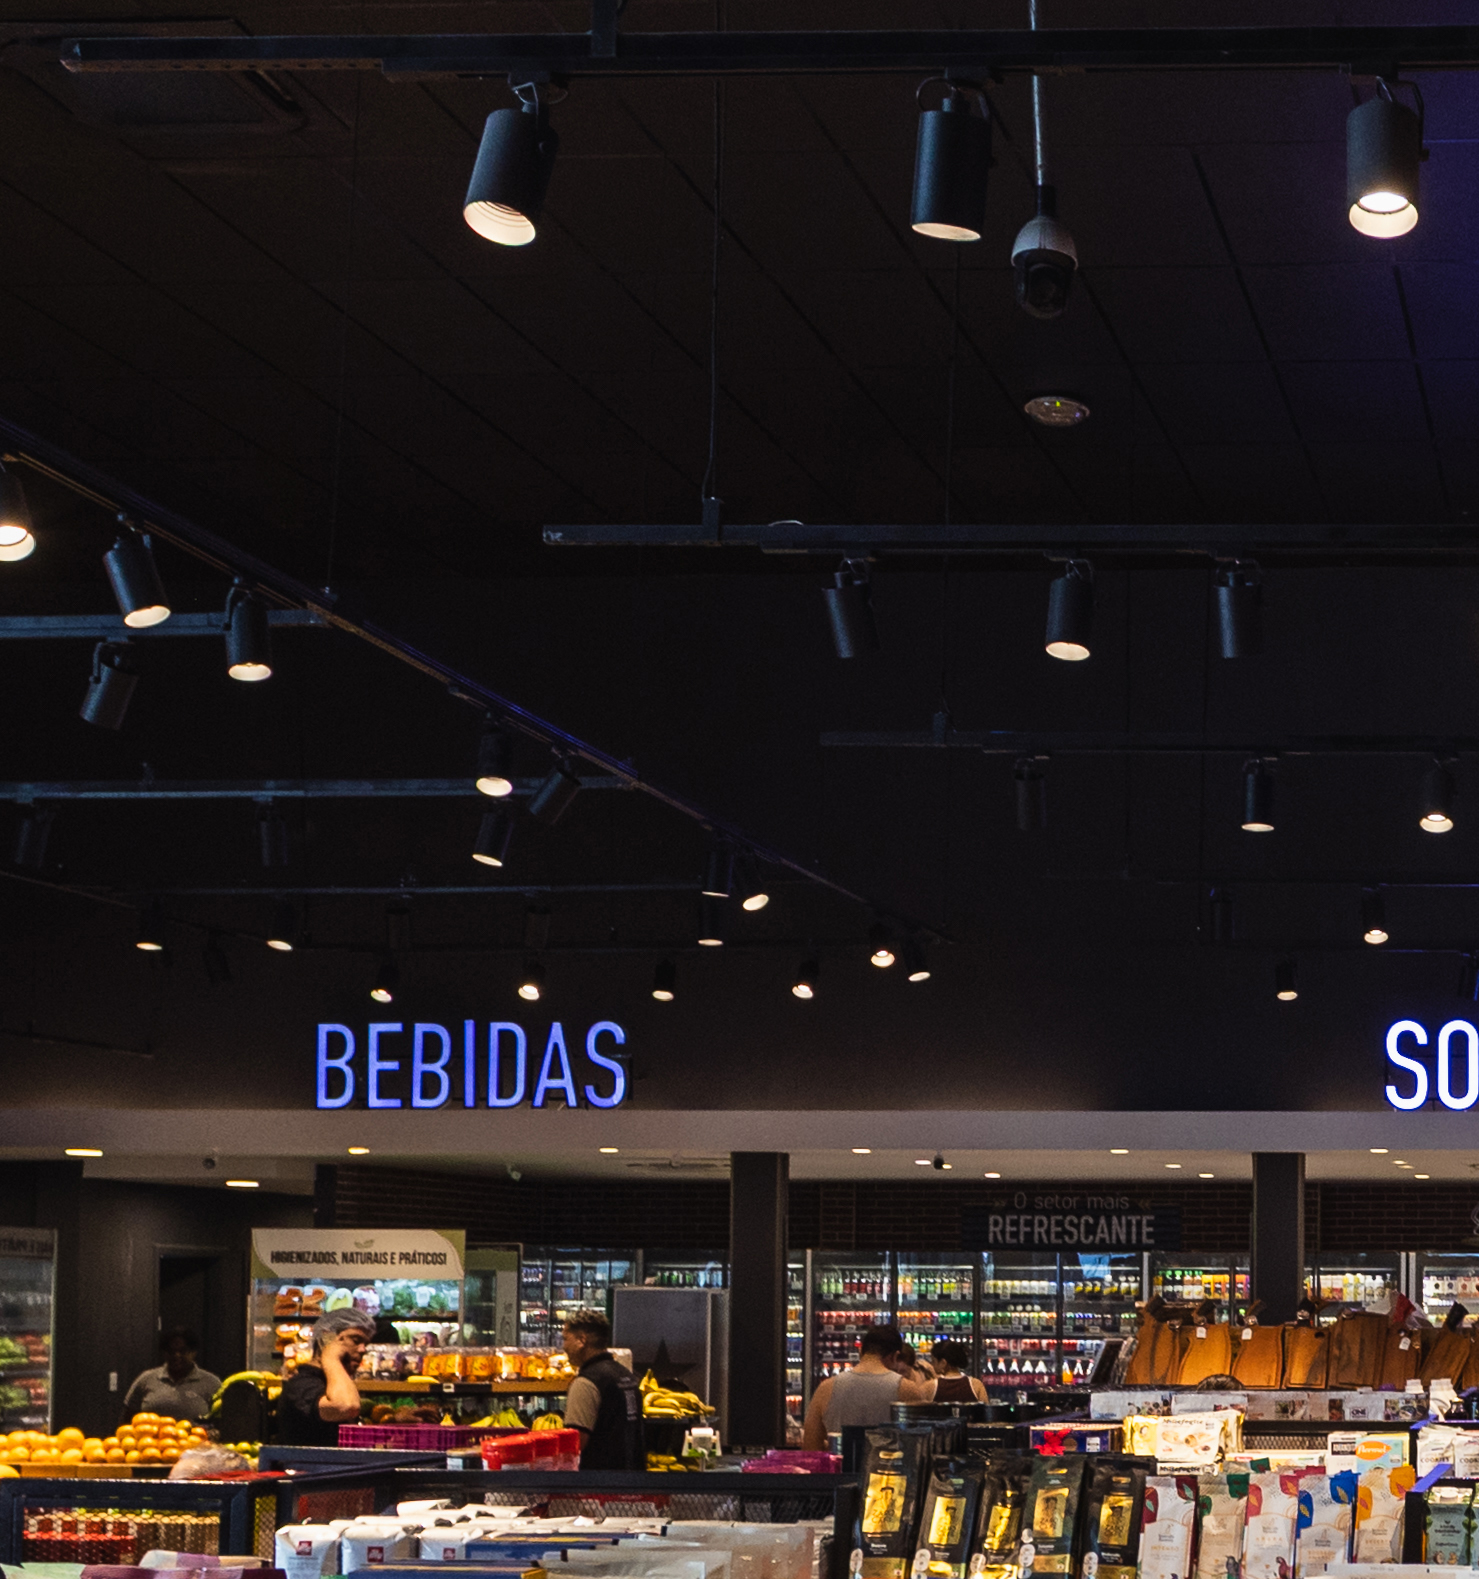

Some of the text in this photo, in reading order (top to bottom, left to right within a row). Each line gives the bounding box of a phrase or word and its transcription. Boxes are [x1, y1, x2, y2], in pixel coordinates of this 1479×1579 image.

[317, 1019, 628, 1109] BEBIDAS
[1014, 1192, 1129, 1209] O setor mais
[988, 1215, 1155, 1244] REFRESCANTE
[342, 1252, 388, 1265] NATURAIS
[391, 1253, 395, 1265] E
[399, 1250, 446, 1265] PRÁTICOS!
